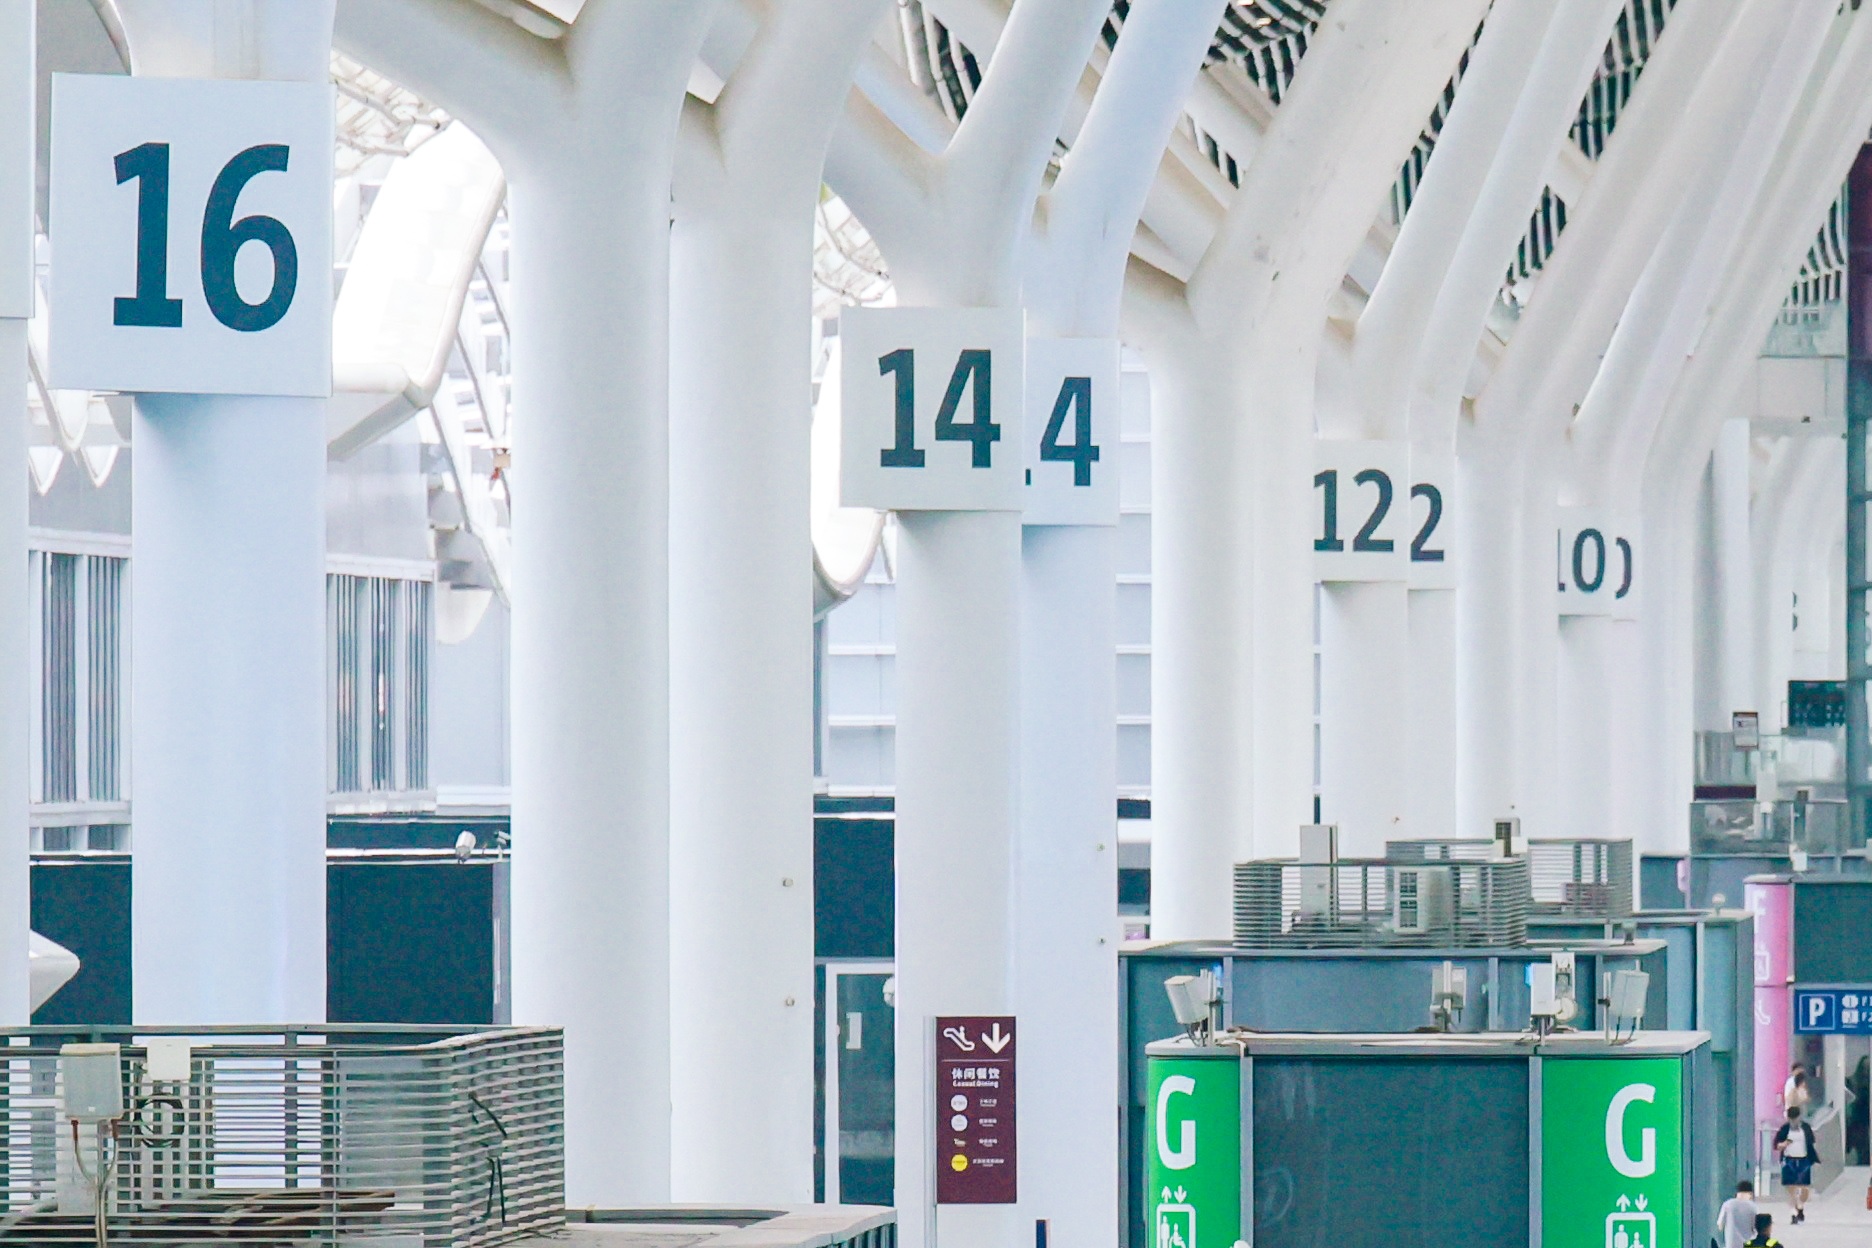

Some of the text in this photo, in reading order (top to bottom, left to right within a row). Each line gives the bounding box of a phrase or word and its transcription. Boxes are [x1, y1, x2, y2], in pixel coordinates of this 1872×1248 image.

[112, 142, 299, 332] 16
[878, 348, 1001, 469] 14
[1025, 376, 1100, 487] 4
[1314, 468, 1395, 552] 12
[1809, 997, 1826, 1026] P
[1155, 1075, 1197, 1172] G
[1606, 1083, 1657, 1179] G
